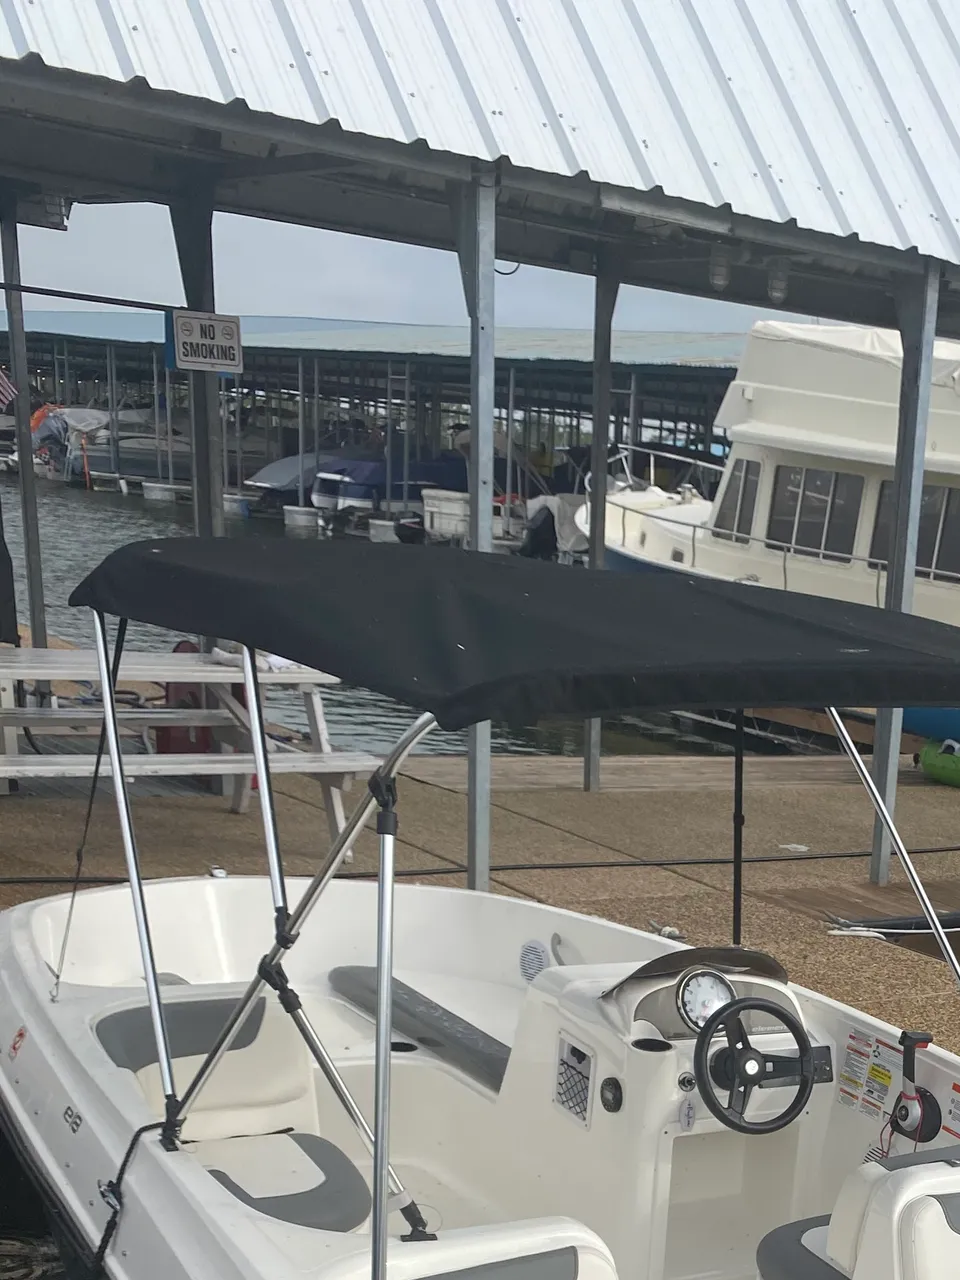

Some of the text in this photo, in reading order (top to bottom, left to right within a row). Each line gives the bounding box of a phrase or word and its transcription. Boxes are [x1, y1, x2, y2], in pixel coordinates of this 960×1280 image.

[200, 323, 215, 340] NO
[182, 341, 236, 361] SMOKING
[751, 1024, 788, 1032] elemen
